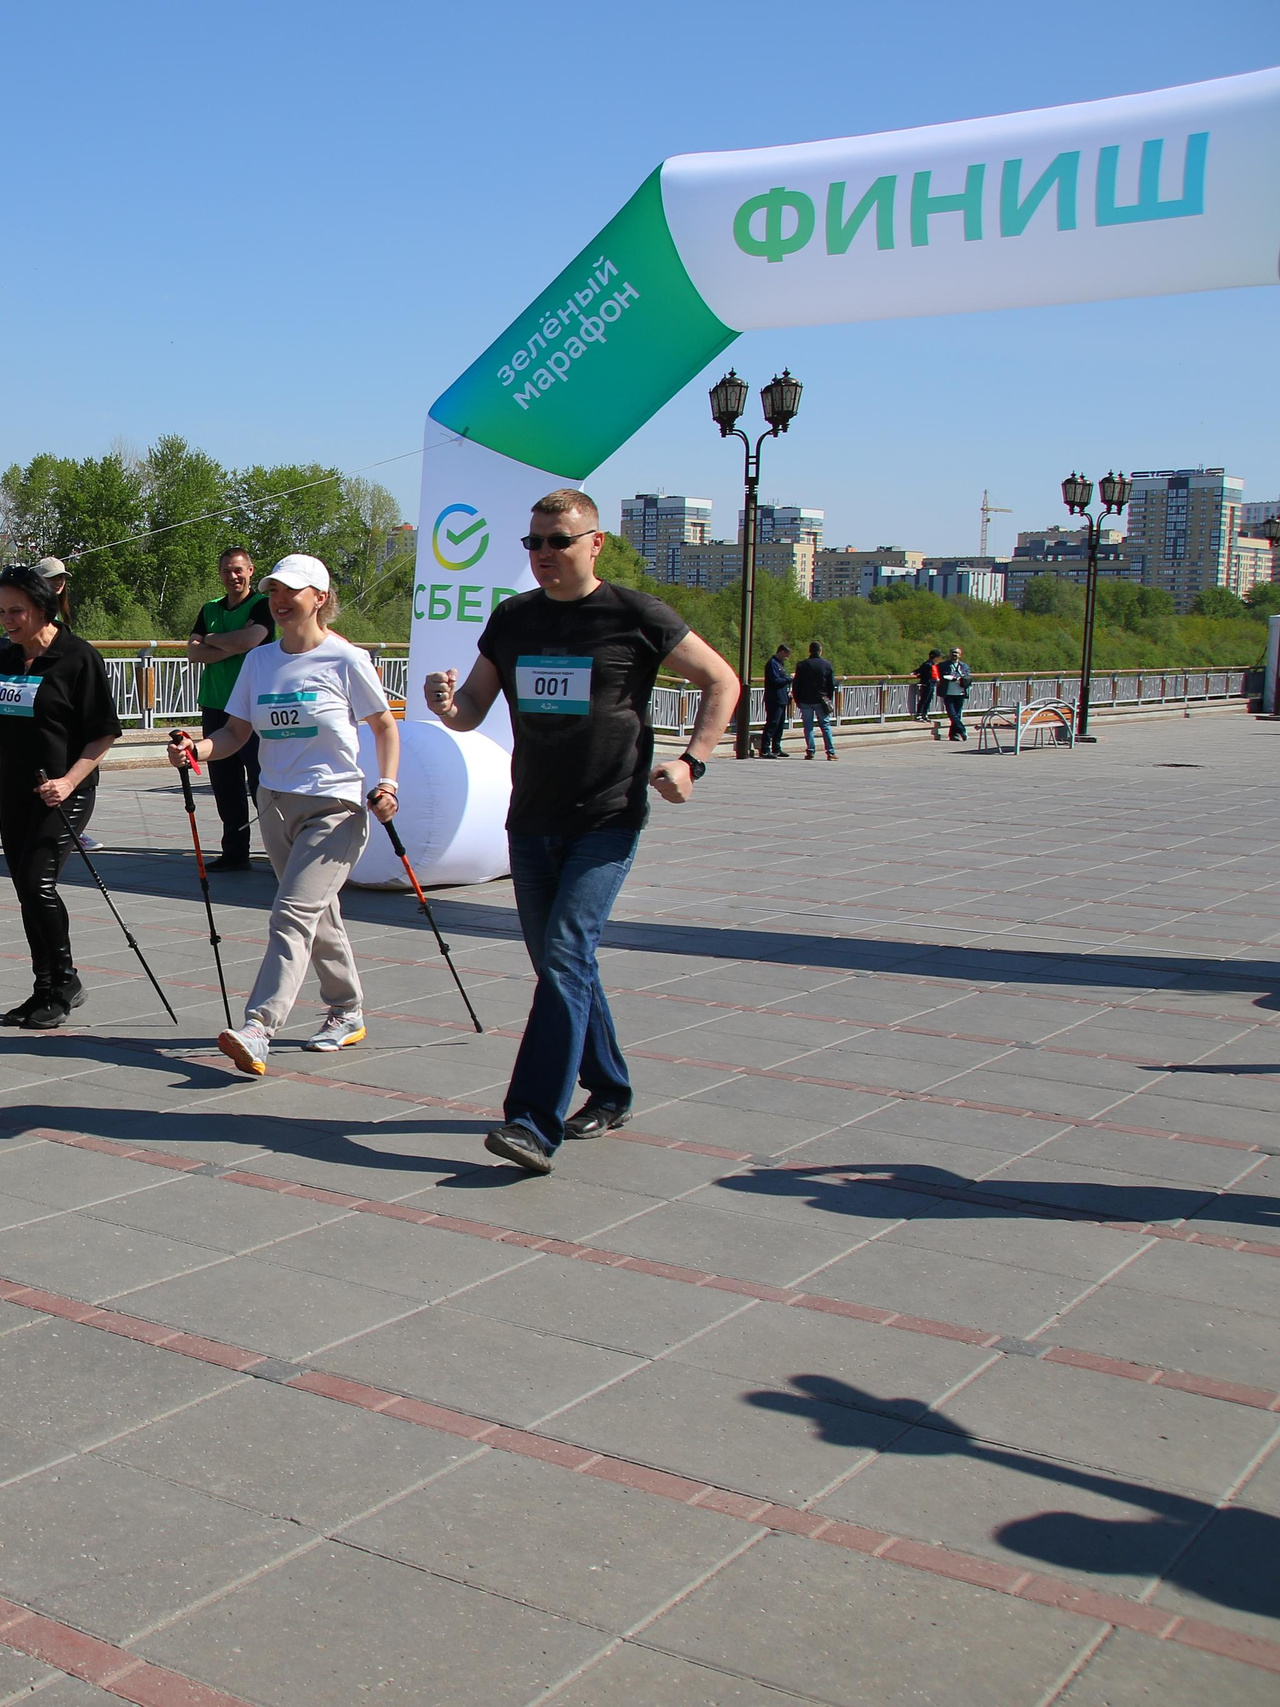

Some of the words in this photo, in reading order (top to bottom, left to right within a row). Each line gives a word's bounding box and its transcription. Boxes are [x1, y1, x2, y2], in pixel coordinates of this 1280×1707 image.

[733, 132, 1209, 263] ФИНИШ
[496, 255, 619, 387] зелёный
[512, 281, 640, 411] марафон
[270, 710, 300, 726] 002
[535, 677, 569, 696] 001
